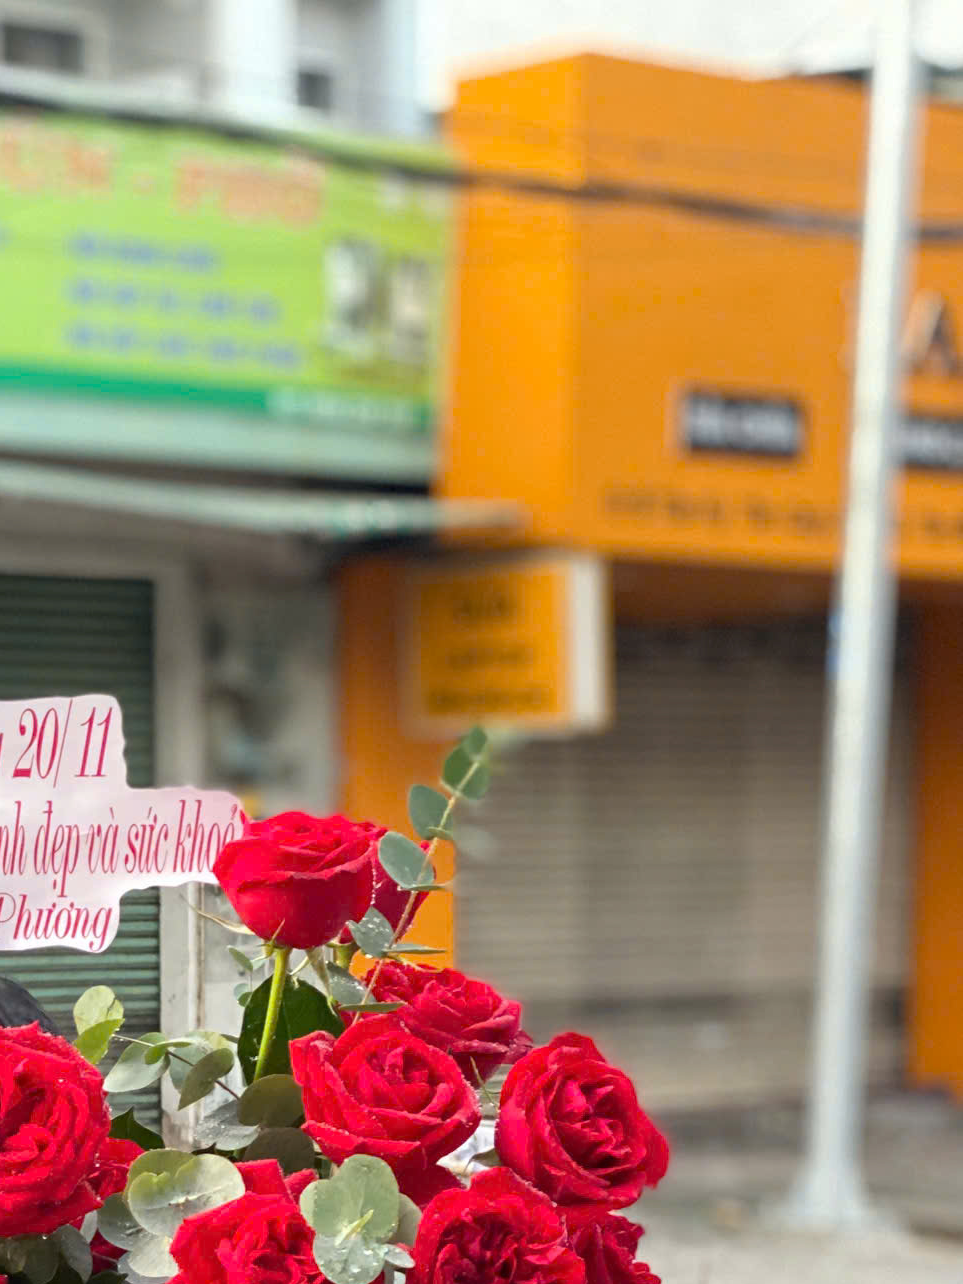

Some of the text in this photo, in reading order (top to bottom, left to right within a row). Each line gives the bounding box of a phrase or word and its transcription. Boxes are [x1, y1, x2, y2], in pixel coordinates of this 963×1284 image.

[33, 800, 81, 898] đẹp
[87, 806, 120, 875] và
[123, 806, 169, 874] sức
